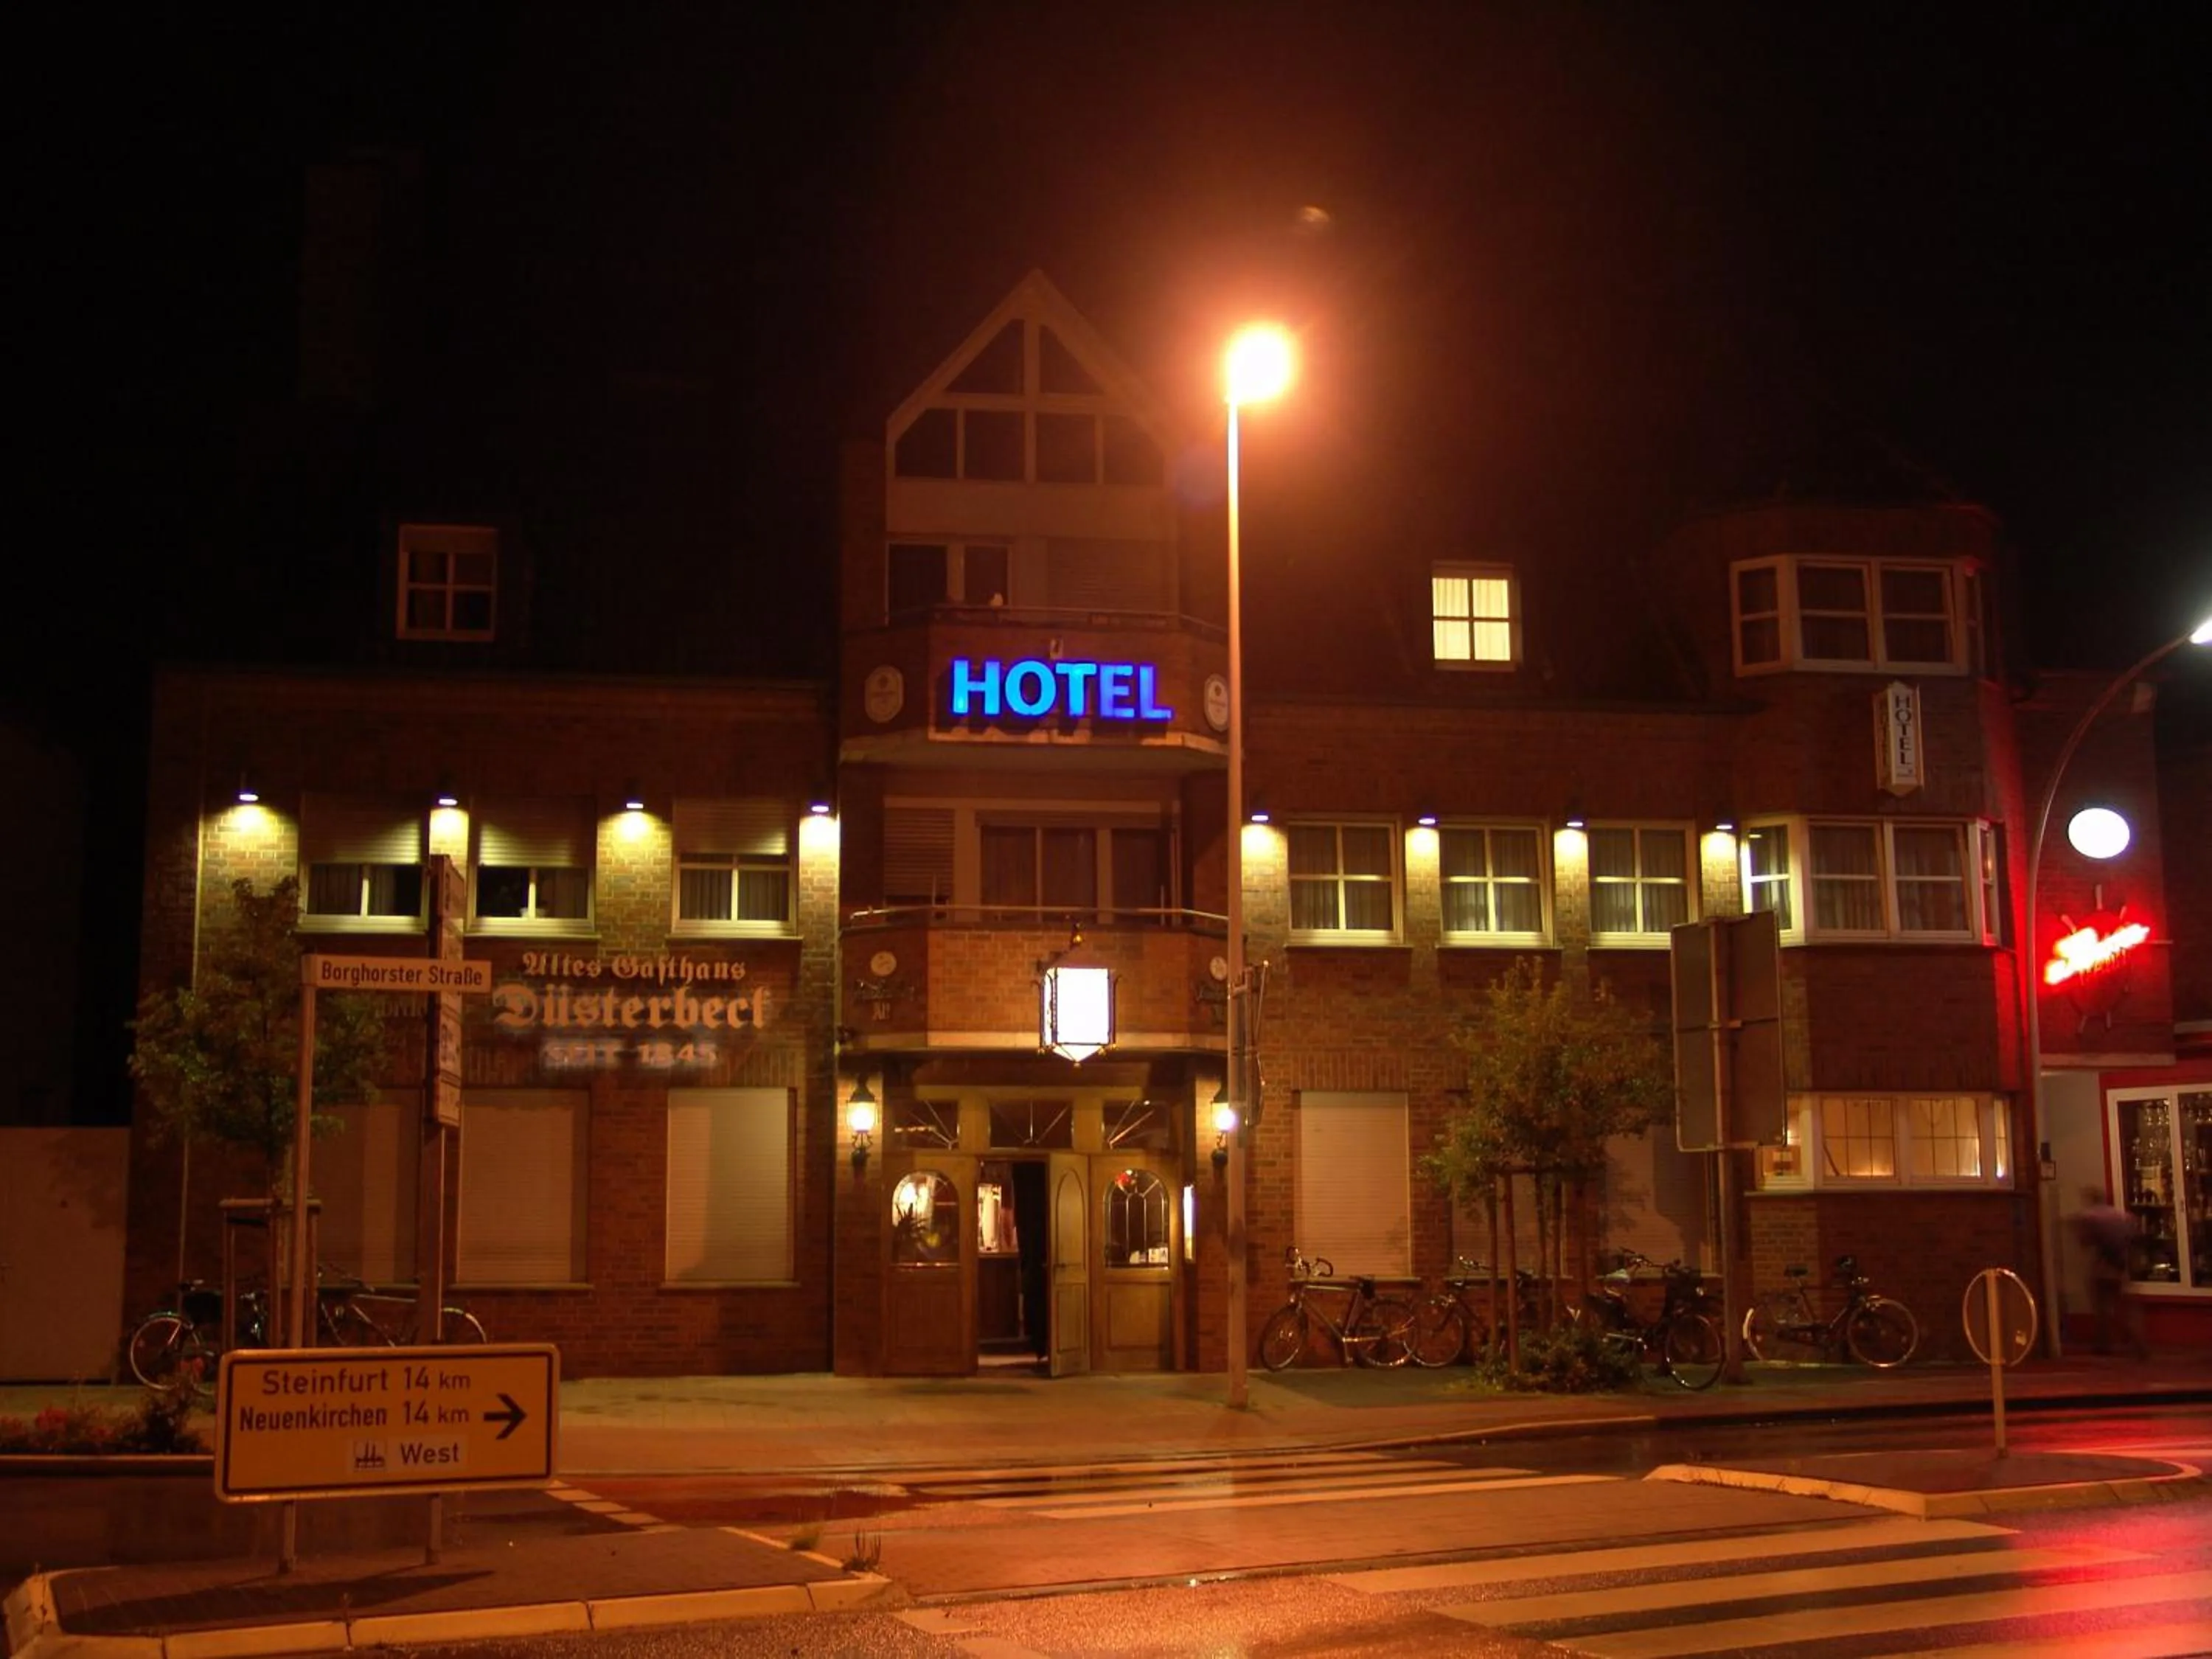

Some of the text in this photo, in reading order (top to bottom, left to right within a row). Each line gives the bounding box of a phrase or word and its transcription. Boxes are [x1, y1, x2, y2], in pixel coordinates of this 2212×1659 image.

[952, 660, 1172, 717] HOTEL
[1895, 695, 1913, 765] HOTEL
[322, 961, 482, 987] Borghorster Straße
[522, 952, 602, 977] Altes
[493, 983, 771, 1029] Düsterbeck
[262, 1366, 470, 1395] Steinfurt 14 km
[240, 1401, 470, 1432] Neuenkirchen 14 km
[400, 1442, 459, 1464] West
